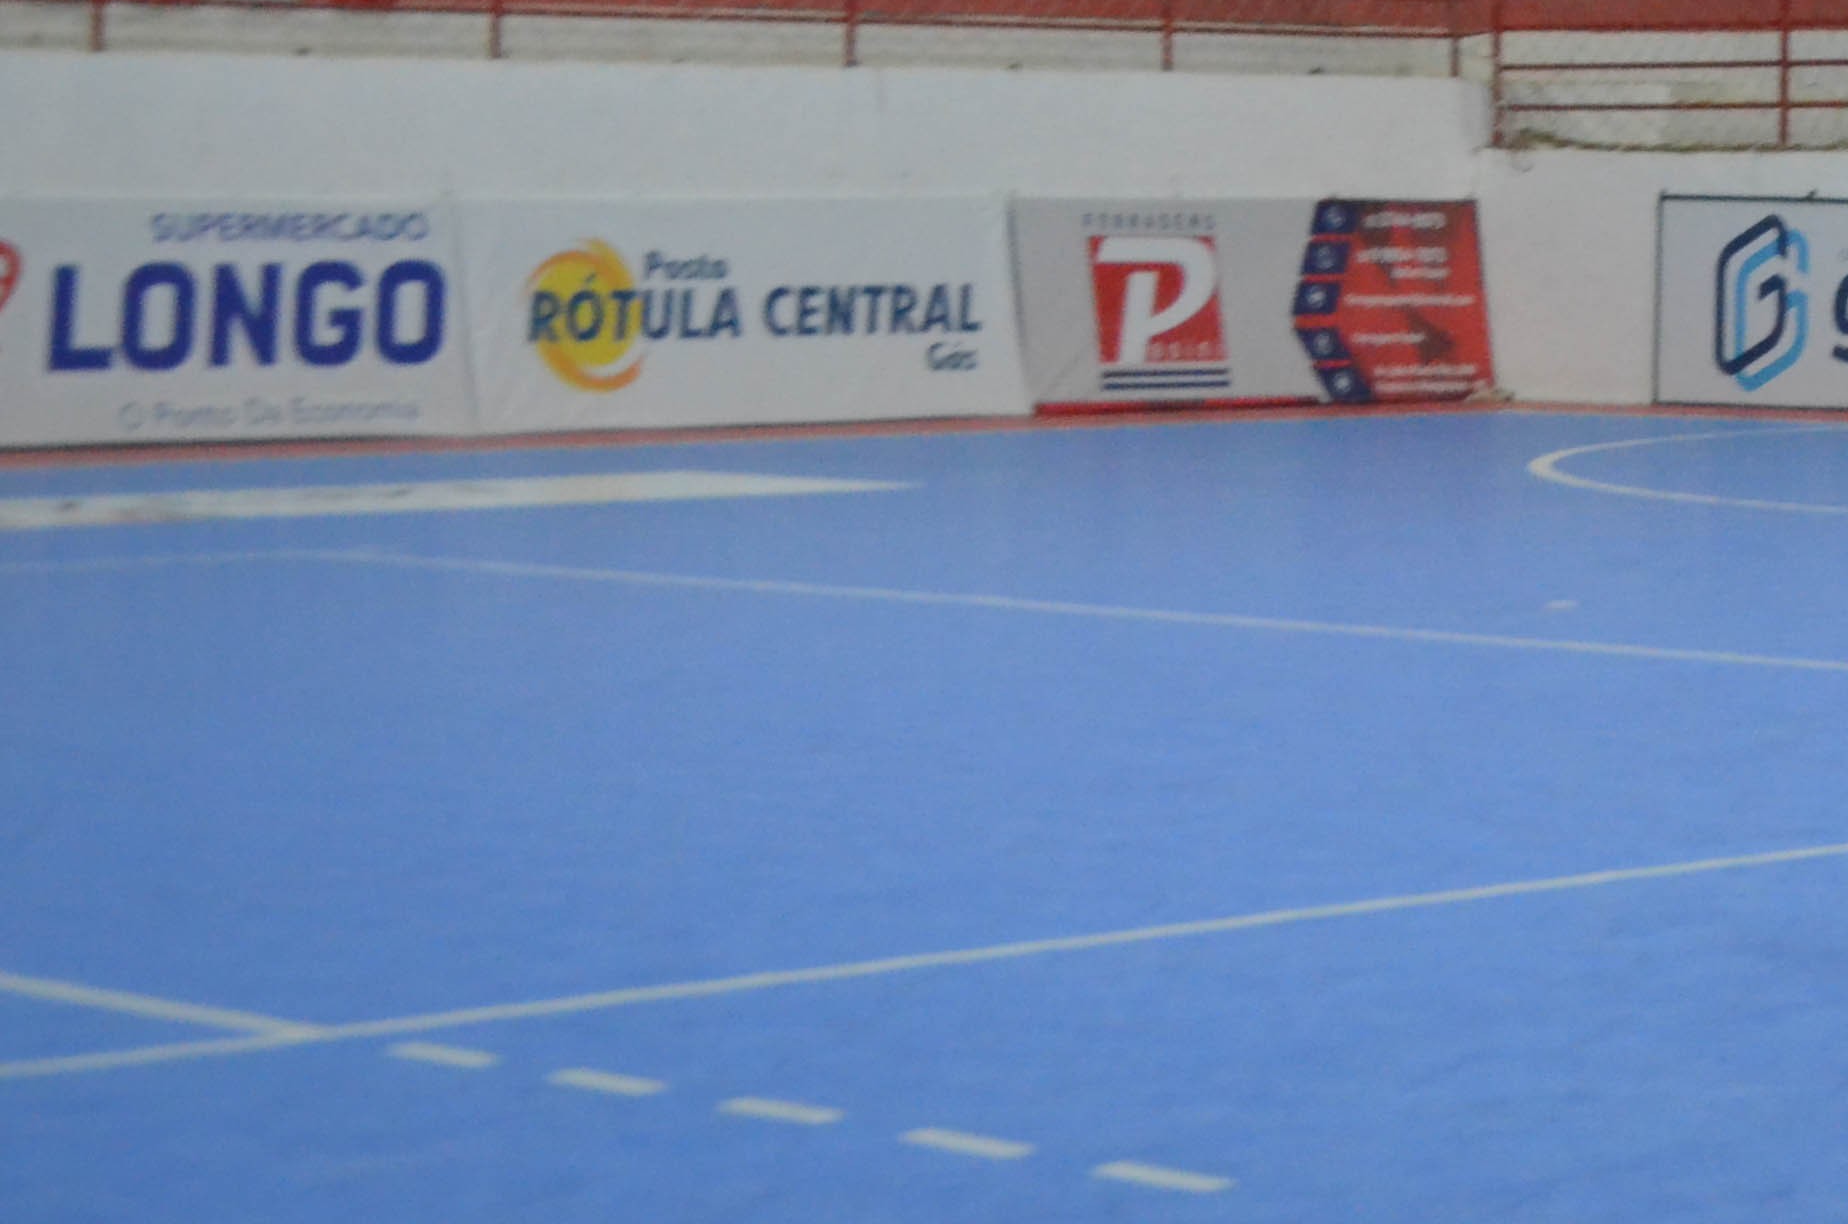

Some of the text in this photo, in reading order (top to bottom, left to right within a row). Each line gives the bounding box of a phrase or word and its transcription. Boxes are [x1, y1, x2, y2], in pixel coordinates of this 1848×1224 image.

[149, 212, 429, 243] SUPERMERCADO
[47, 258, 447, 372] LONGO
[529, 274, 982, 343] RÓTULA CENTRAL
